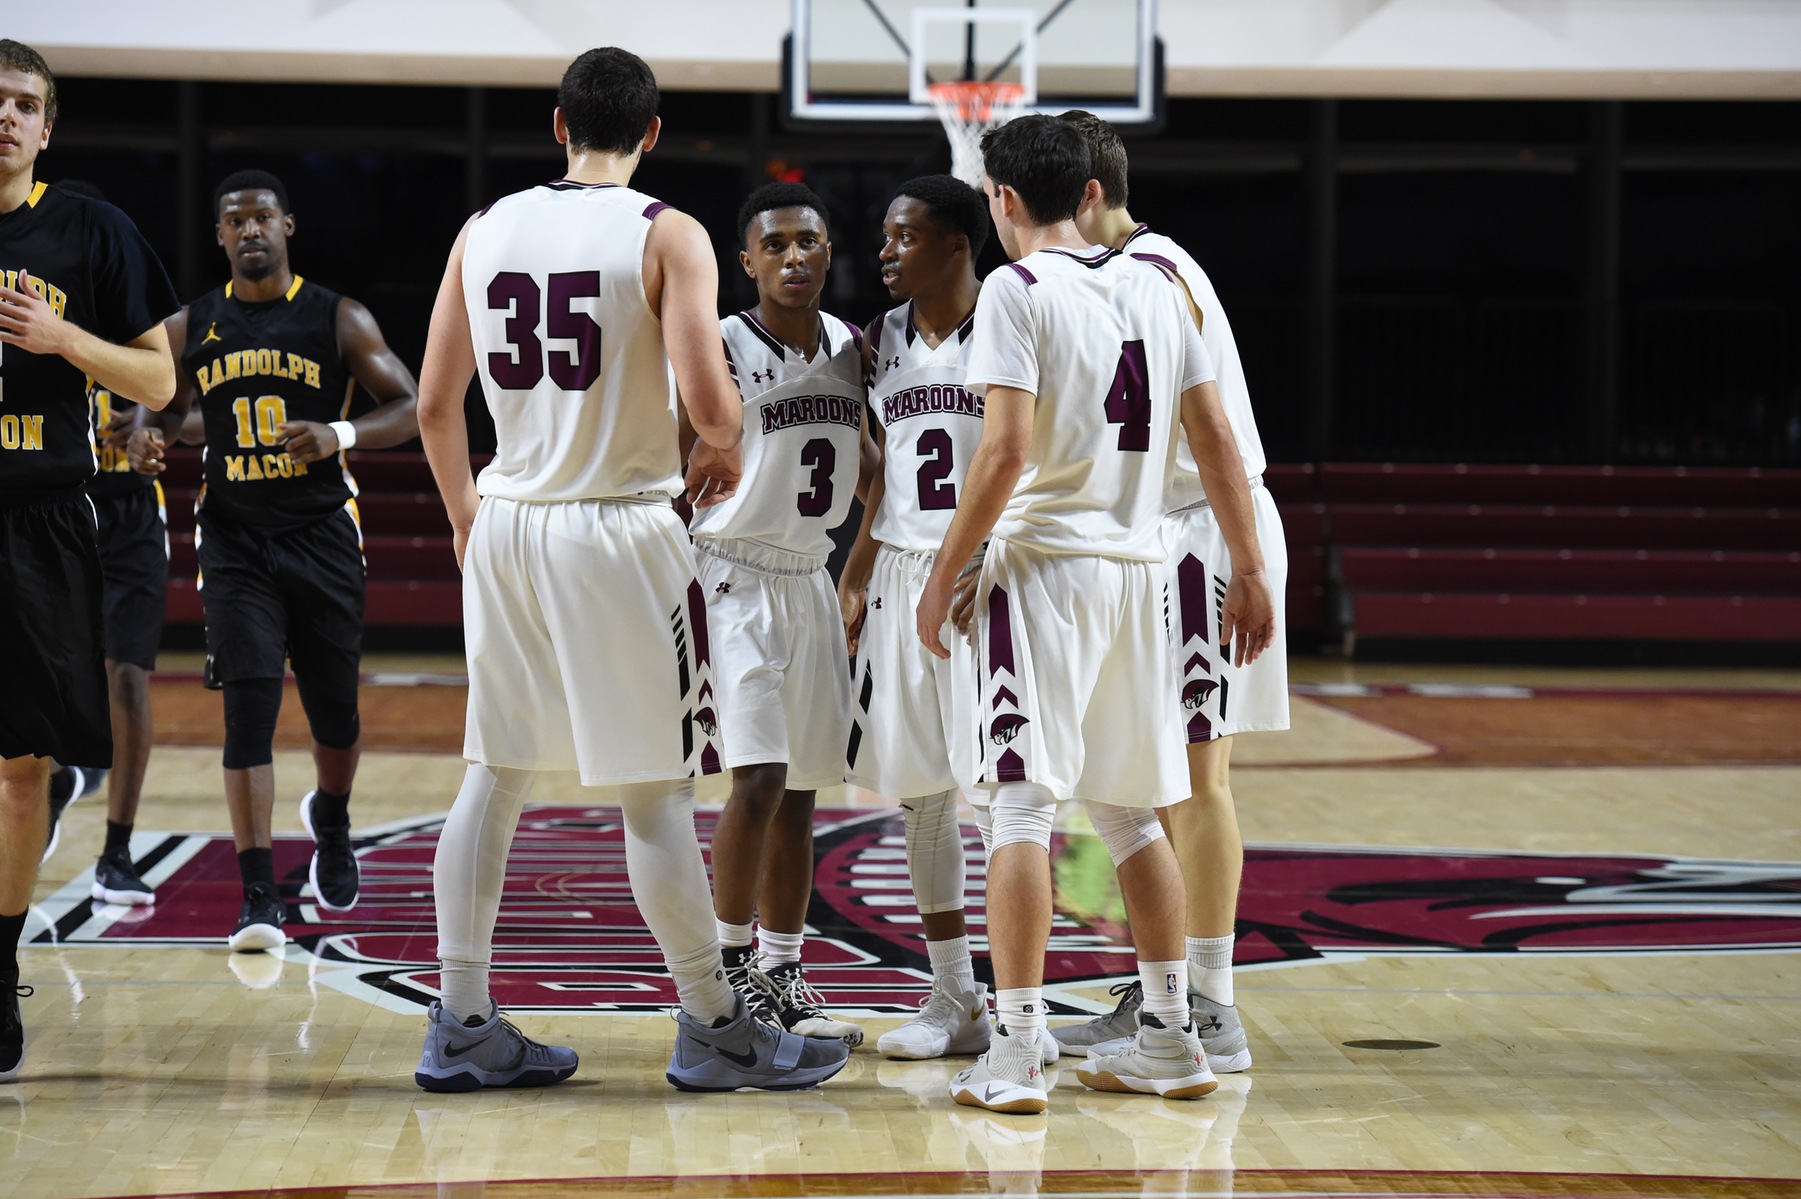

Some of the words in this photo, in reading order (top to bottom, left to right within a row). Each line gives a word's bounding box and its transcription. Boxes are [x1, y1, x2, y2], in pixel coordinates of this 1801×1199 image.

[487, 270, 602, 391] 35
[196, 348, 321, 396] RANDOLPH
[1104, 339, 1152, 452] 4
[232, 395, 288, 448] 10
[760, 395, 862, 435] MAROONS
[797, 438, 836, 517] 3
[917, 428, 957, 511] 2
